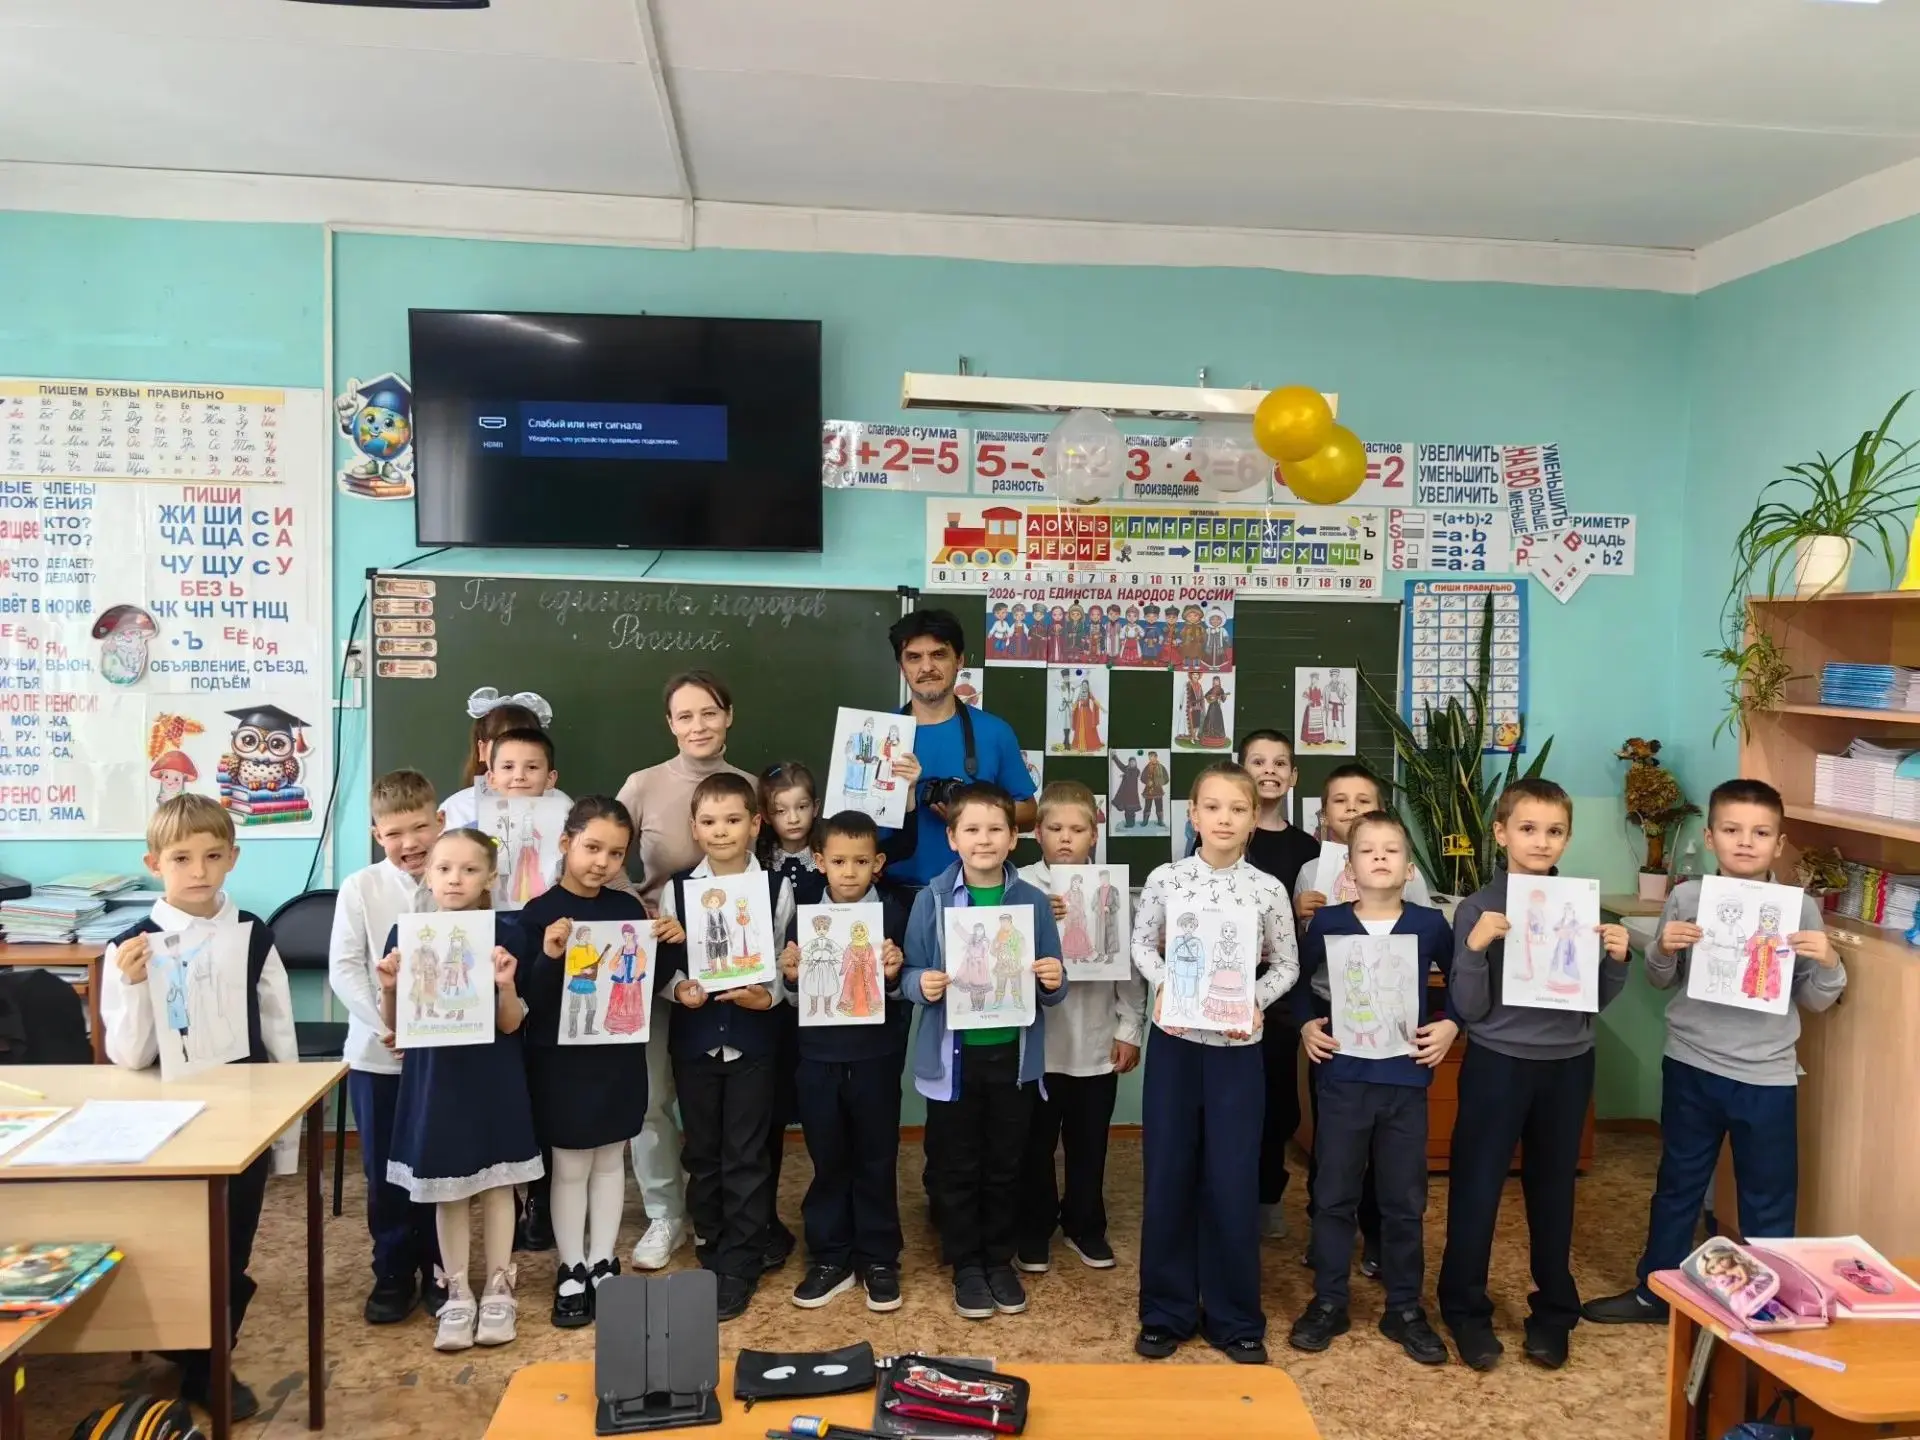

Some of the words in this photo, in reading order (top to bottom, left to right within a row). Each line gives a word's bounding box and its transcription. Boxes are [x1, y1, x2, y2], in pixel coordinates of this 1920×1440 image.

[39, 385, 88, 396] ПИШЕМ
[96, 387, 140, 397] БУКВЫ
[147, 389, 224, 400] ПРАВИЛЬНО
[528, 418, 566, 428] Слабый
[587, 421, 602, 429] нет
[605, 422, 642, 431] сигнала
[913, 427, 957, 440] сумма
[1363, 442, 1402, 453] астное
[1420, 445, 1499, 462] УВЕЛИЧИТЬ
[1419, 465, 1498, 483] УМЕНЬШИТЬ
[43, 482, 96, 495] ЧЛЕНЫ
[992, 480, 1044, 493] разность
[1135, 484, 1199, 497] произведение
[1543, 443, 1568, 527] УМЕНЬШИТЬ
[184, 487, 240, 503] ПИШИ
[1419, 486, 1498, 504] УВЕЛИЧИТЬ
[159, 505, 195, 524] ЖИ
[204, 506, 242, 525] ШИ
[275, 507, 293, 526] И
[1529, 488, 1548, 531] БОЛЬШЕ
[45, 516, 91, 529] КТО?
[44, 533, 92, 546] ЧТО?
[161, 526, 194, 545] ЧА
[202, 527, 244, 549] ЩА
[275, 528, 293, 547] А
[12, 558, 38, 568] ЧТО
[47, 558, 94, 569] ДЕЛАЕТ?
[161, 555, 193, 574] ЧУ
[203, 556, 244, 578] ЩУ
[276, 557, 293, 575] У
[12, 572, 38, 582] ЧТО
[46, 573, 96, 584] ДЕЛАЮТ?
[1151, 575, 1162, 584] 10
[1172, 575, 1182, 585] 11
[1193, 575, 1204, 585] 12
[1214, 576, 1225, 586] 13
[1235, 576, 1246, 586] 14
[1256, 576, 1267, 586] 15
[1276, 577, 1288, 587] 16
[1297, 577, 1309, 587] 17
[1319, 577, 1330, 587] 18
[1340, 578, 1351, 588] 19
[1360, 578, 1372, 588] 20
[181, 581, 222, 596] БЕЗ
[989, 588, 1045, 600] 2026-ГОД
[1049, 587, 1112, 600] ЕДИНСТВА
[1117, 588, 1174, 600] НАРОДОВ
[1179, 588, 1234, 600] РОССИИ
[1434, 584, 1460, 592] ПИШИ
[1463, 584, 1512, 592] ПРАВИЛЬНО
[0, 592, 27, 613] вёт
[151, 601, 178, 618] ЧК
[185, 601, 214, 618] ЧН
[221, 601, 248, 618] ЧТ
[253, 602, 288, 622] НЩ
[151, 660, 249, 674] ОБЪЯВЛЕНИЕ,
[254, 660, 308, 674] СЪЕЗД,
[191, 677, 250, 690] ПОДЪЁМ
[50, 807, 85, 820] ЯМА
